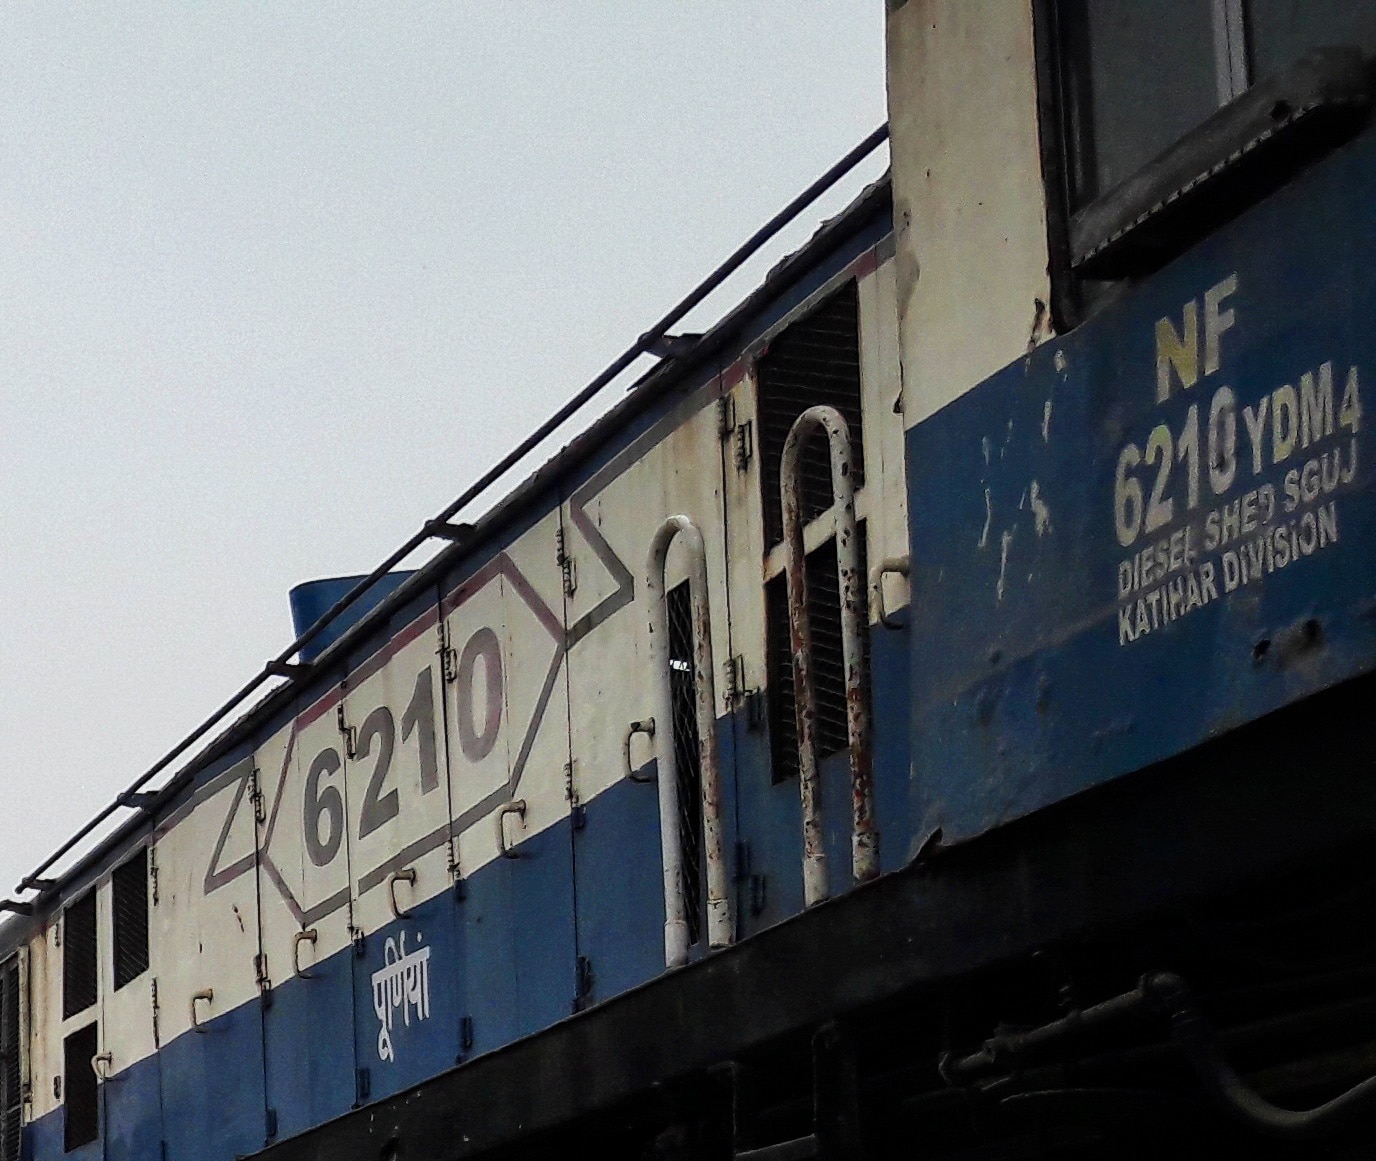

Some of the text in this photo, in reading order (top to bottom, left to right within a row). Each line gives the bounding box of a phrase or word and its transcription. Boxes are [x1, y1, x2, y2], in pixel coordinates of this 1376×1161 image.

[1155, 272, 1237, 405] NF
[1115, 360, 1361, 547] 6210 YDM4
[1119, 526, 1195, 598] DIESEL
[1284, 437, 1358, 512] SGUJ
[1119, 561, 1218, 646] KATIHAR
[304, 627, 502, 867] 6210
